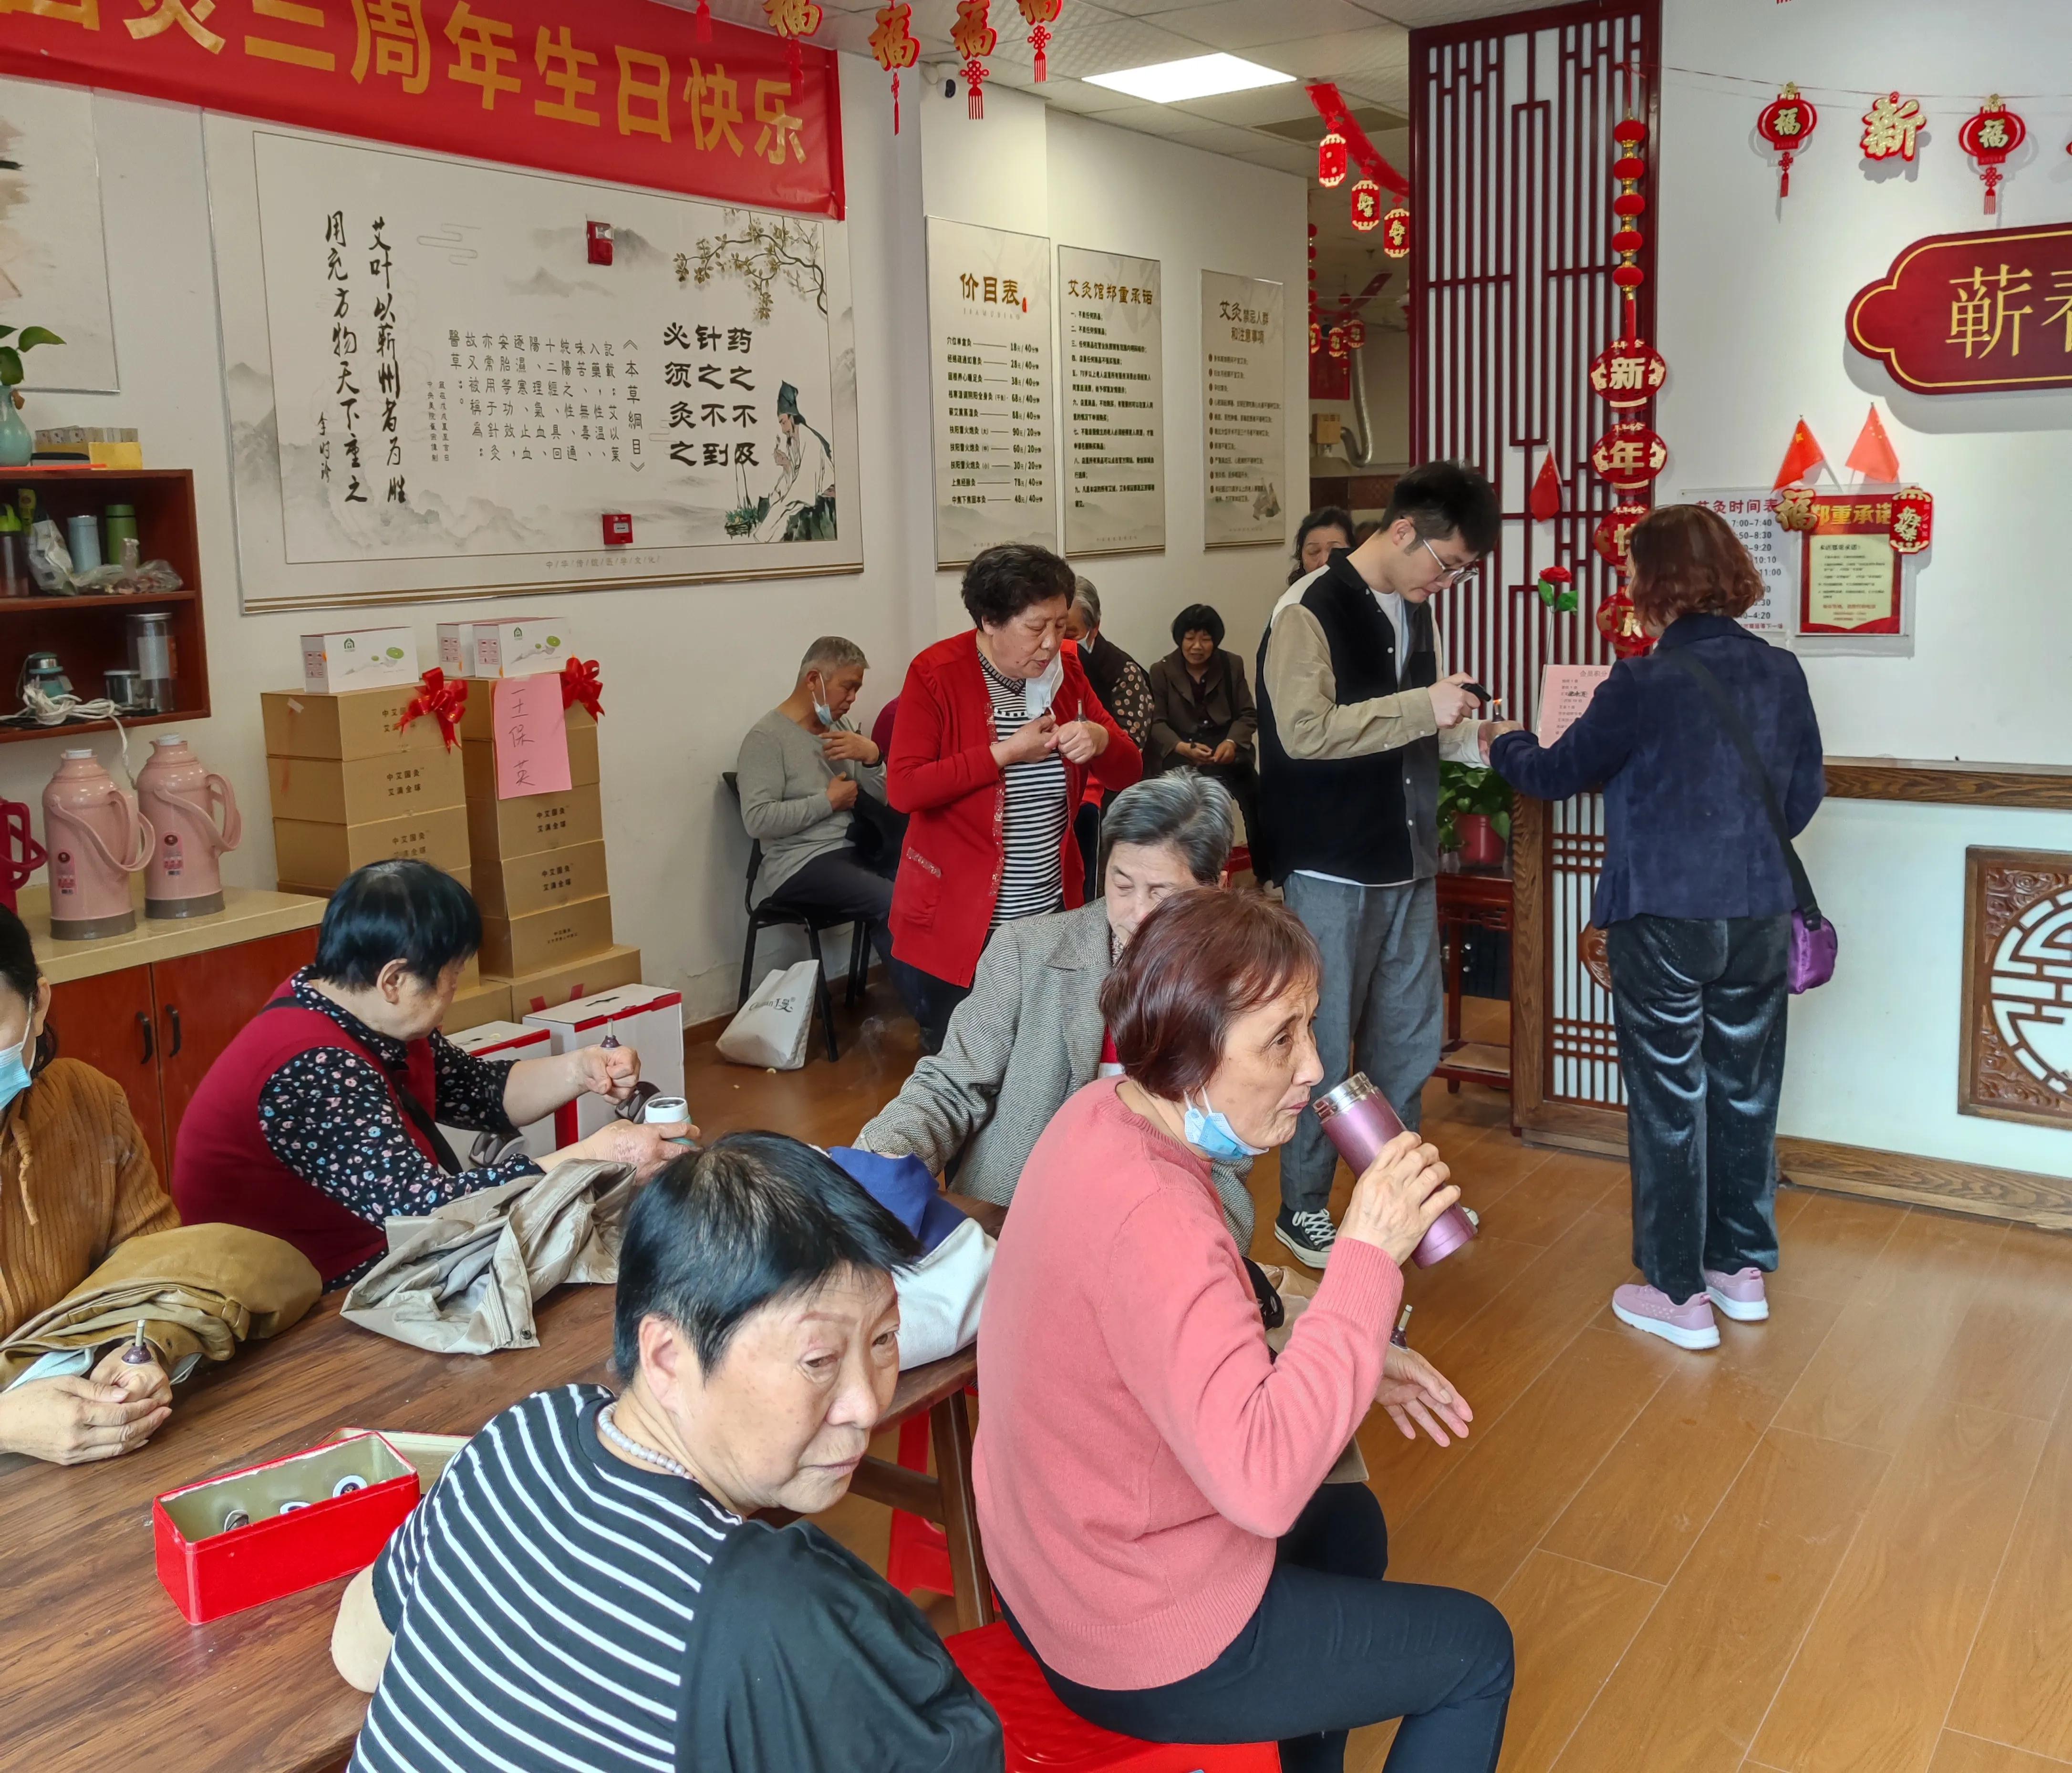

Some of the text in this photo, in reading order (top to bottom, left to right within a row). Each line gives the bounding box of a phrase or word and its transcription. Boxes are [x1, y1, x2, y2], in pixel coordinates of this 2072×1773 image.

[868, 3, 917, 71] 福
[951, 0, 996, 60] 福
[0, 0, 807, 165] 三周年生日快乐
[1773, 107, 1801, 135] 福
[1860, 94, 1926, 159] 新
[1979, 118, 2010, 148] 福
[960, 272, 1021, 306] 价目表
[1068, 278, 1153, 306] 艾灸馆郑重承诺
[1609, 357, 1646, 390] 新
[663, 322, 697, 466] 必须灸之
[695, 325, 729, 466] 针之不到
[727, 327, 759, 467] 药之不及
[1608, 440, 1645, 475] 年
[1731, 519, 1772, 527] 7:00-7:40
[1773, 488, 1818, 531] 福
[1736, 531, 1772, 539] :50-8:30
[508, 688, 536, 786] 王保英
[386, 768, 420, 781] 中艾国灸
